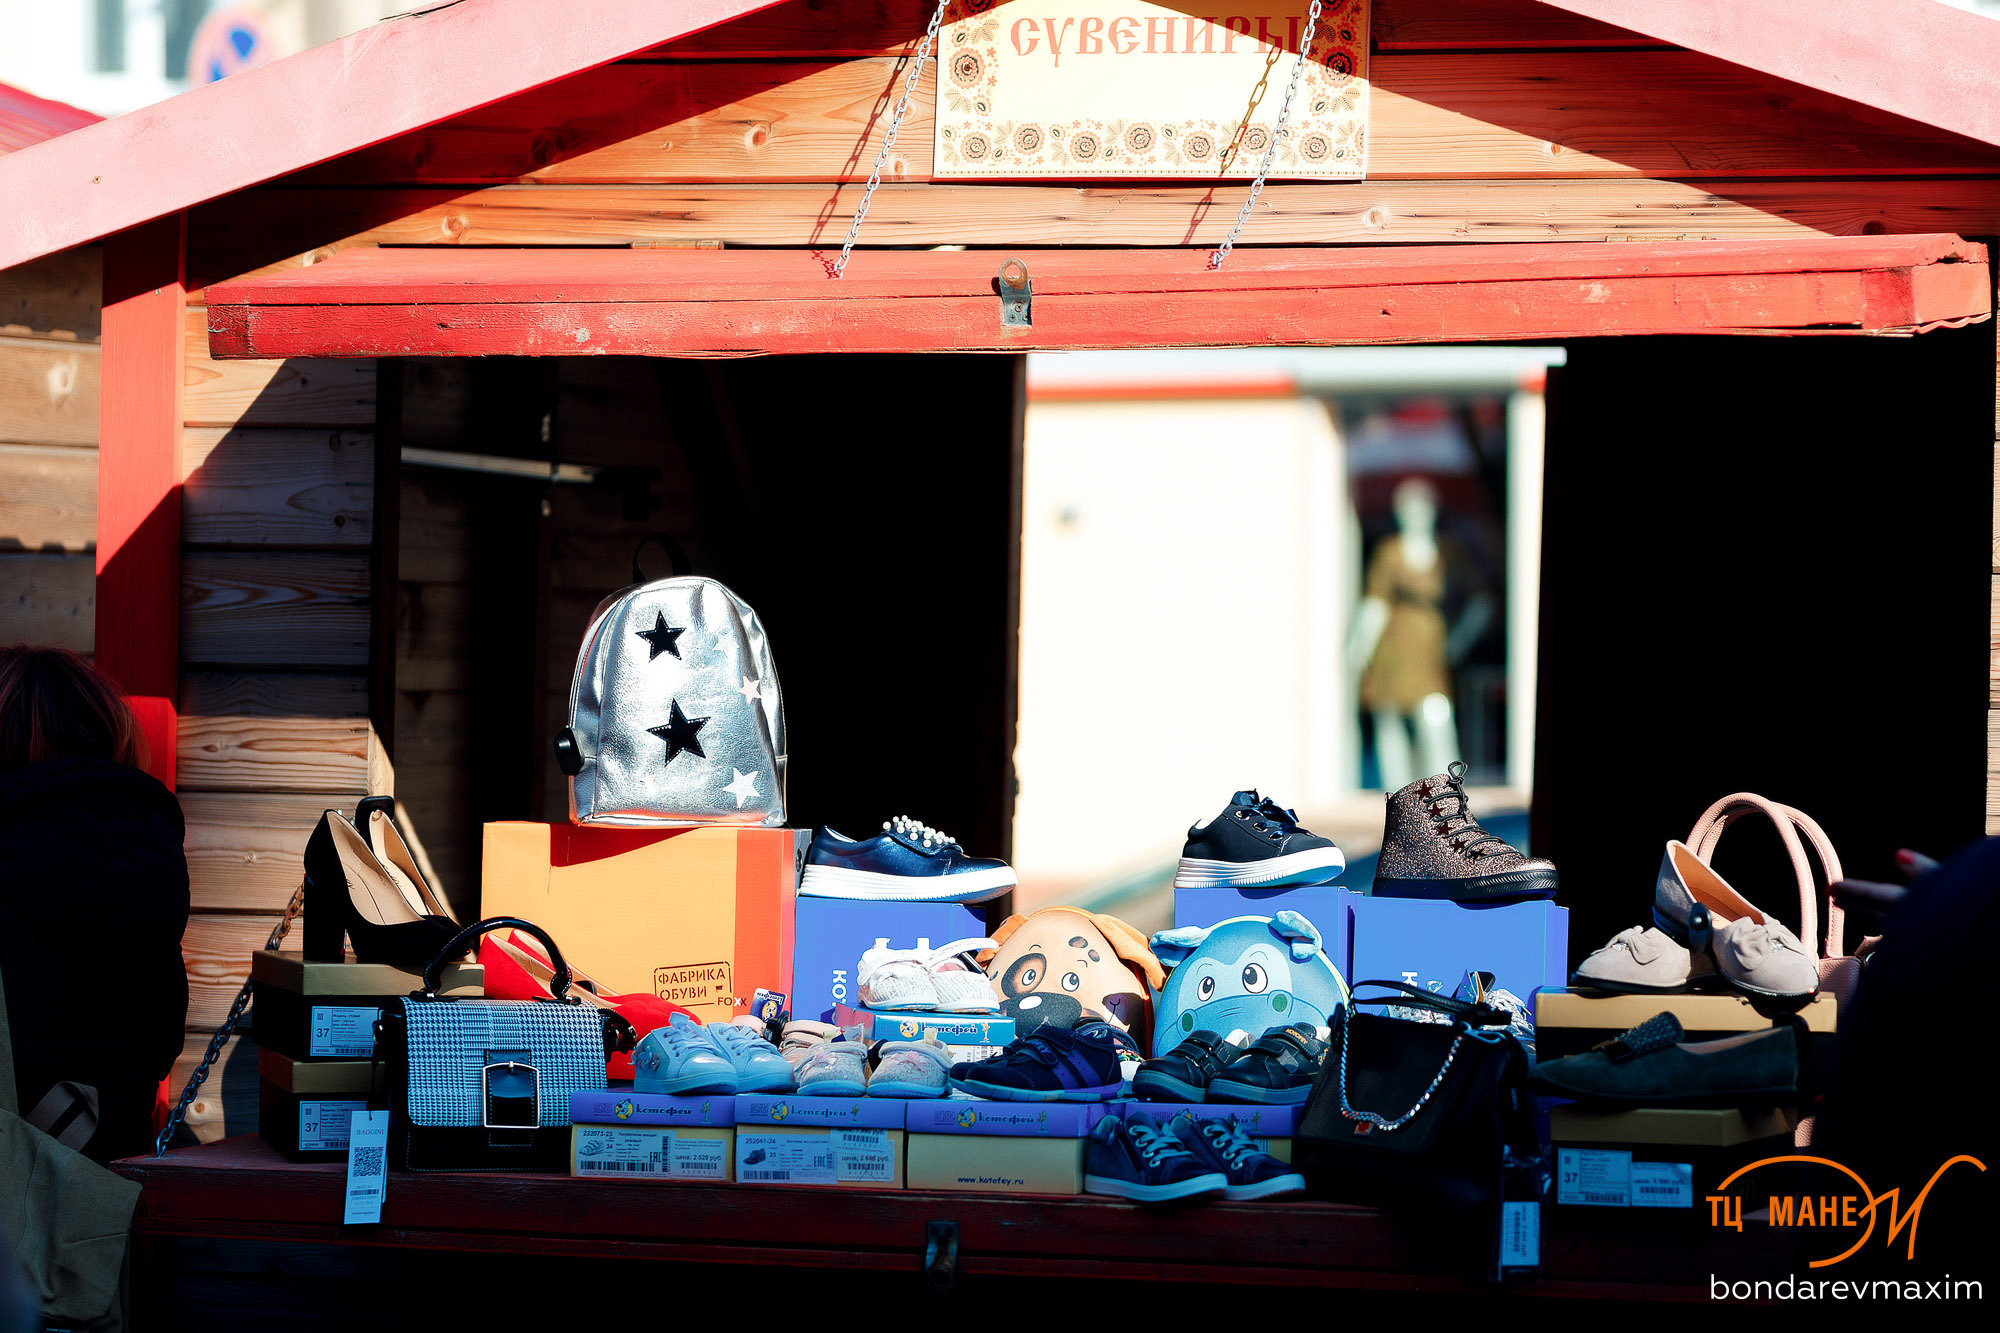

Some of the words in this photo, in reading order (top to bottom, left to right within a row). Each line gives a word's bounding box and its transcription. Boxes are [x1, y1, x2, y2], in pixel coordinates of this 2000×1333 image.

[1010, 16, 1302, 67] СУВЕНИРЫ
[658, 968, 726, 985] ФАБРИКА
[659, 985, 707, 1001] ОБУВИ
[717, 996, 748, 1007] FOXX
[316, 1027, 331, 1038] 37
[304, 1122, 319, 1133] 37
[356, 1128, 385, 1136] BAGGINI
[957, 1175, 1025, 1187] www.kotofey.ru
[1563, 1171, 1579, 1184] 37
